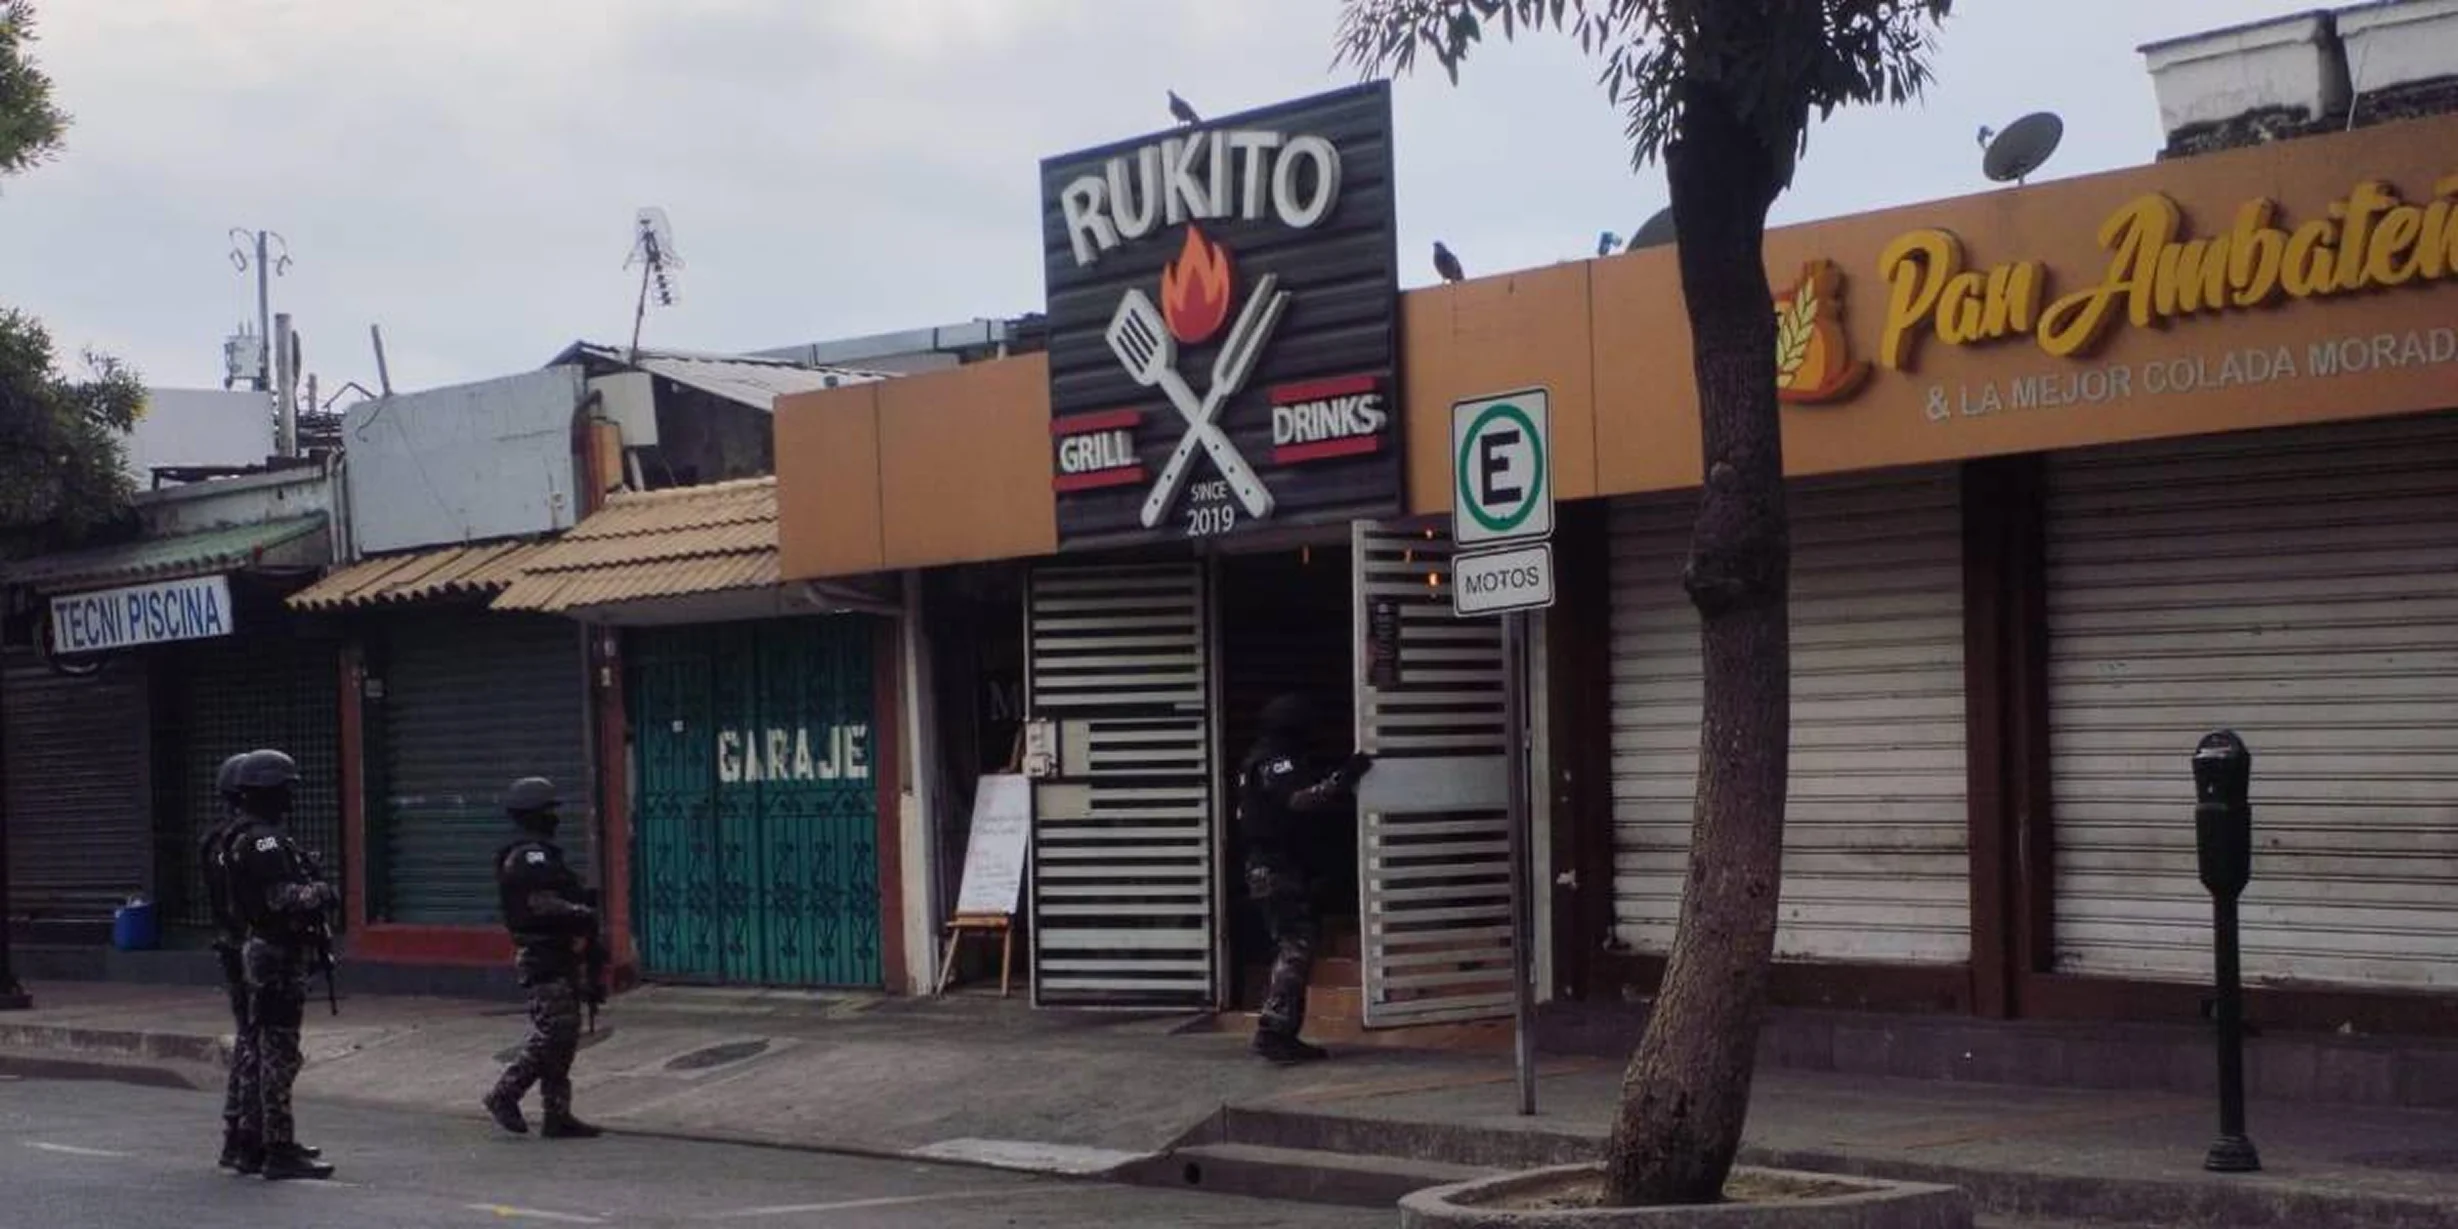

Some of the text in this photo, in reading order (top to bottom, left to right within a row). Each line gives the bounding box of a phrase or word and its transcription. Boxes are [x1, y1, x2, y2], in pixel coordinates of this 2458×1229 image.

[1061, 130, 1341, 265] RUKITO
[1879, 228, 2044, 370] Pan
[1926, 328, 2458, 420] & LA MEJOR COLADA MORAD
[1271, 394, 1386, 445] DRINKS
[1059, 431, 1139, 474] GRILL
[1480, 429, 1521, 505] E
[1186, 505, 1235, 536] 2019
[1190, 481, 1229, 501] SINCE
[1465, 566, 1540, 594] MOTOS
[55, 585, 223, 649] TECNI PISCINA
[717, 724, 869, 783] GARAJE
